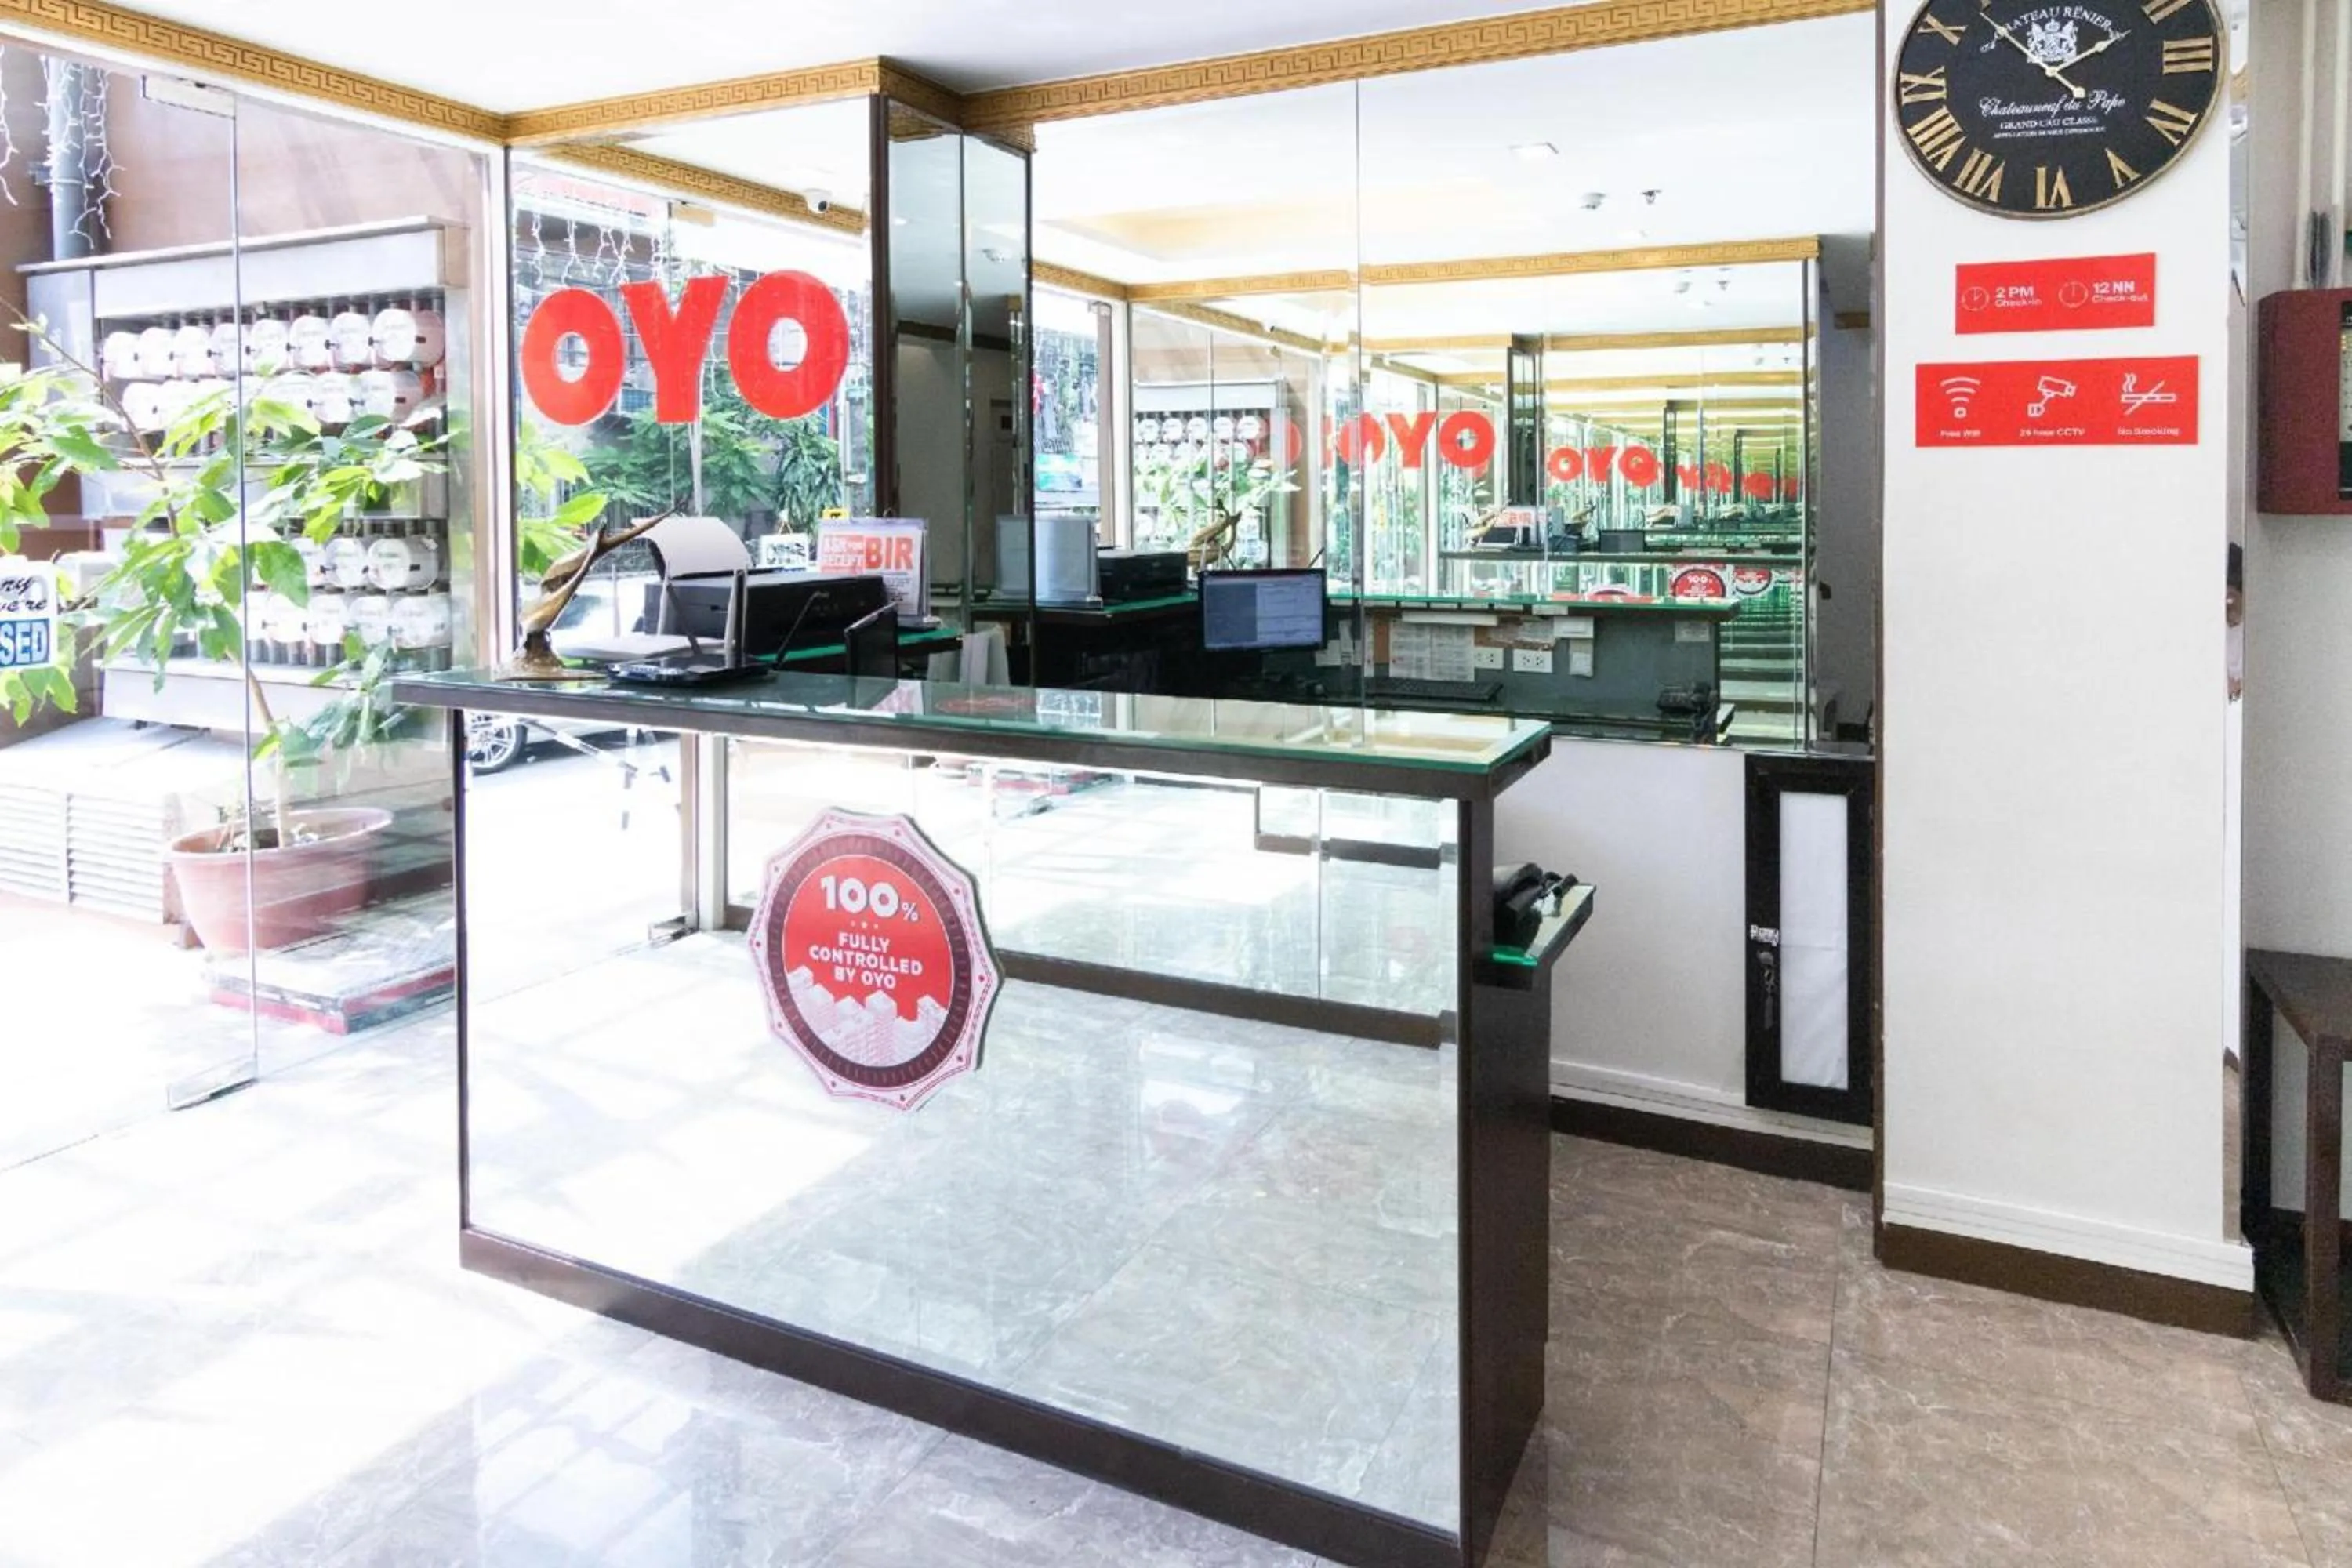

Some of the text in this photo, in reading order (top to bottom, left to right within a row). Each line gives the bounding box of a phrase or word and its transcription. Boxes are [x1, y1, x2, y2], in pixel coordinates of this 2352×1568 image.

[1917, 13, 1967, 46] X
[2162, 36, 2213, 74] III
[1995, 285, 2034, 298] 2 PM
[2092, 280, 2135, 294] 12 NN
[521, 269, 850, 426] OYO
[2056, 427, 2086, 437] CCTV
[865, 536, 913, 570] BIR
[0, 598, 48, 612] e're
[0, 621, 47, 664] SED
[820, 874, 919, 922] 100%
[838, 931, 890, 954] FULLY
[809, 945, 923, 976] CONTROLLED
[834, 966, 897, 990] BY OYO
